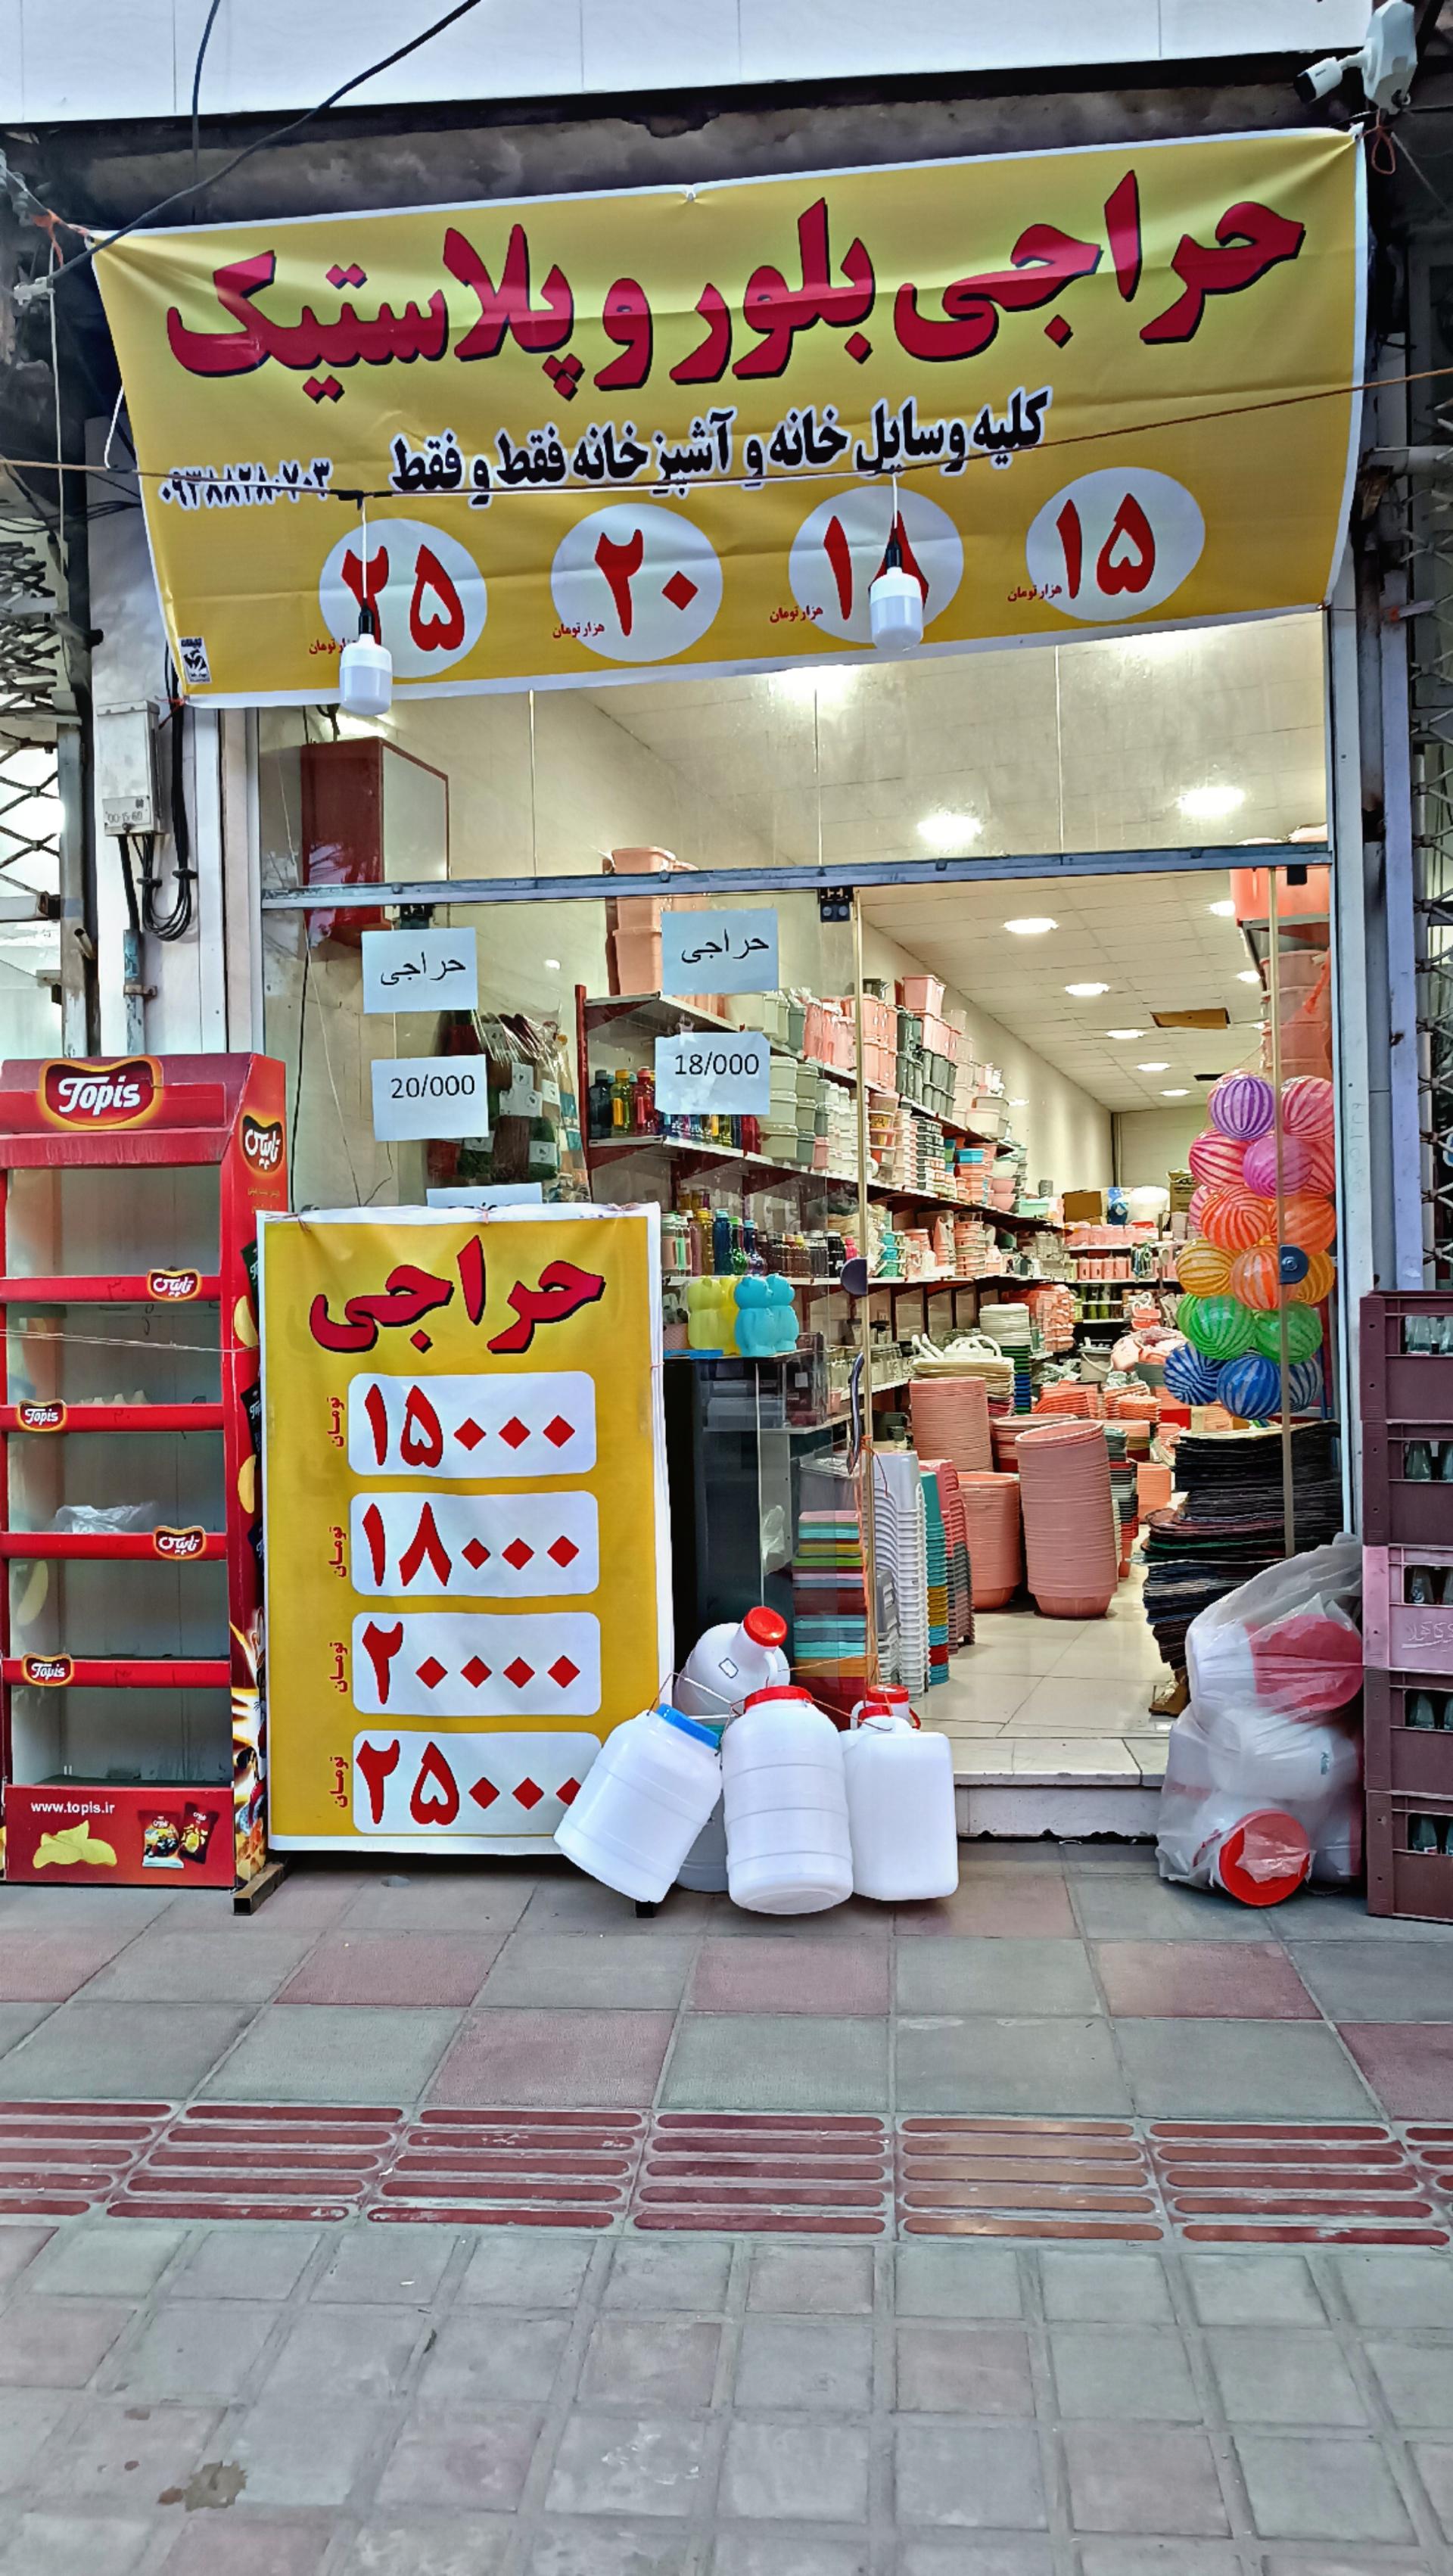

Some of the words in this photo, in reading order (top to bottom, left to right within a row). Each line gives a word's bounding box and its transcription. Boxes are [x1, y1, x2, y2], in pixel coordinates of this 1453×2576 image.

[669, 197, 876, 387] بلور
[893, 170, 1307, 363] حراجی
[166, 222, 586, 402] پلاستیک
[594, 277, 654, 390] و
[769, 408, 849, 467] خانه
[855, 400, 966, 476] وسایل
[972, 389, 1050, 466] کلیه
[391, 431, 464, 490] فقط
[496, 425, 568, 485] فقط
[744, 438, 764, 488] و
[471, 457, 491, 506] و
[1056, 492, 1156, 599] ۱۵
[341, 543, 465, 652] ۲۵
[594, 528, 699, 637] ۲۰
[1007, 584, 1038, 602] تومان
[1038, 583, 1063, 600] هزار
[552, 621, 581, 639] تومان
[582, 621, 605, 637] هزار
[769, 605, 799, 624] تومان
[800, 605, 824, 621] هزار
[380, 950, 467, 986] حراجی
[681, 928, 770, 964] حراجی
[390, 1073, 475, 1099] 20/000
[674, 1051, 760, 1076] 18/000
[58, 1075, 141, 1116] Topis
[309, 1234, 607, 1354] حراجی
[25, 1408, 59, 1426] Topis
[326, 1396, 344, 1448] تومان
[364, 1383, 576, 1469] ۱۵۰۰۰
[328, 1526, 347, 1578] تومان
[362, 1501, 580, 1588] ۱۸۰۰۰
[31, 1662, 66, 1681] Topis
[328, 1641, 348, 1694] تومان
[362, 1620, 581, 1705] ۲۰۰۰۰
[30, 1800, 116, 1816] www.topis.ir
[328, 1756, 349, 1808] تومان
[355, 1738, 582, 1826] ۲۵۰۰۰
